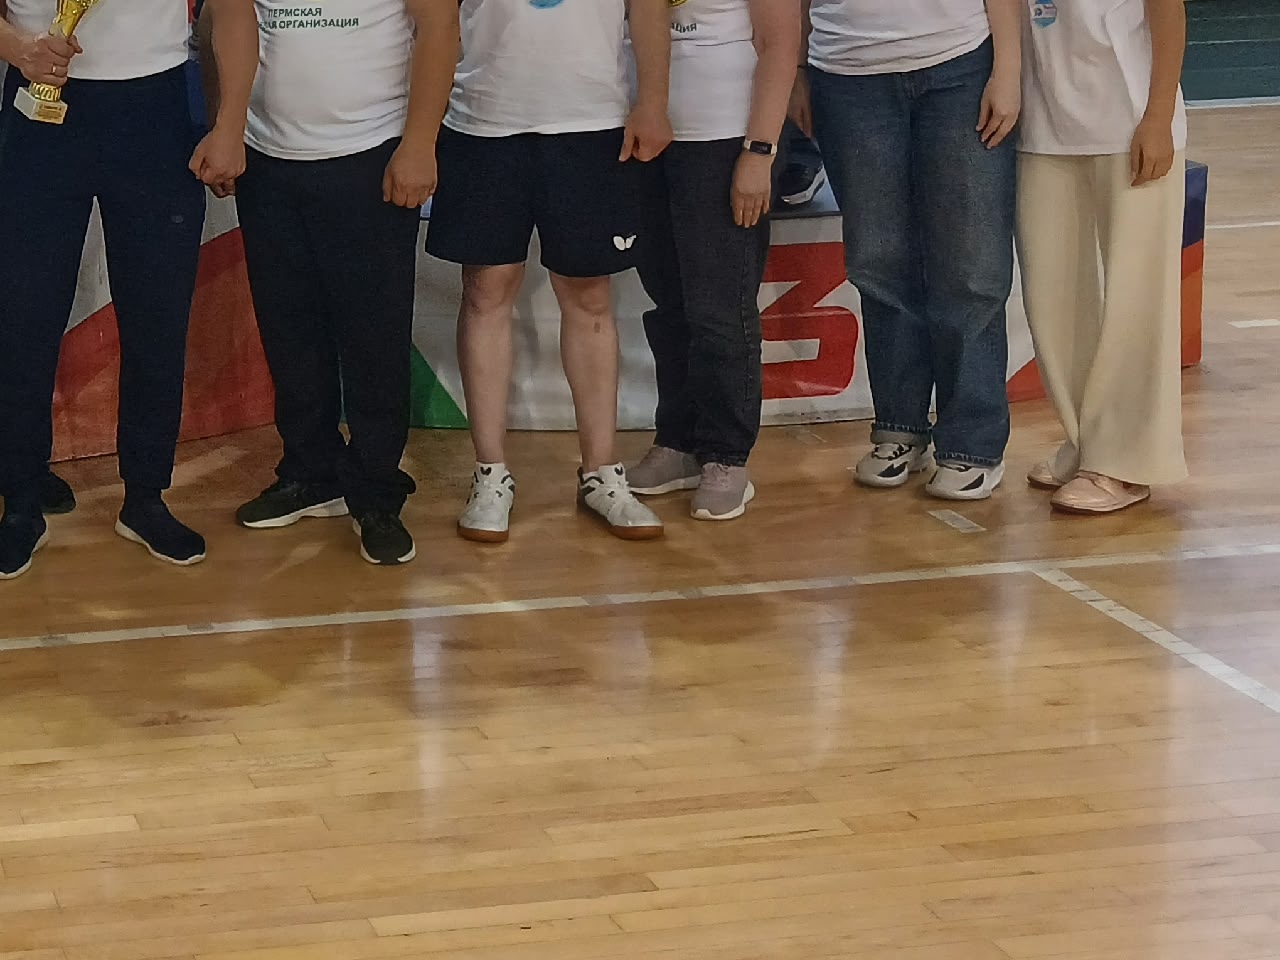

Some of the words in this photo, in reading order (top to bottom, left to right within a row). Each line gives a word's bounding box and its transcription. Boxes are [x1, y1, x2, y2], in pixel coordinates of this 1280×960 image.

[268, 7, 322, 18] ПЕРМСКАЯ
[279, 18, 360, 29] ОРГАНИЗАЦИЯ
[761, 241, 859, 400] 3
